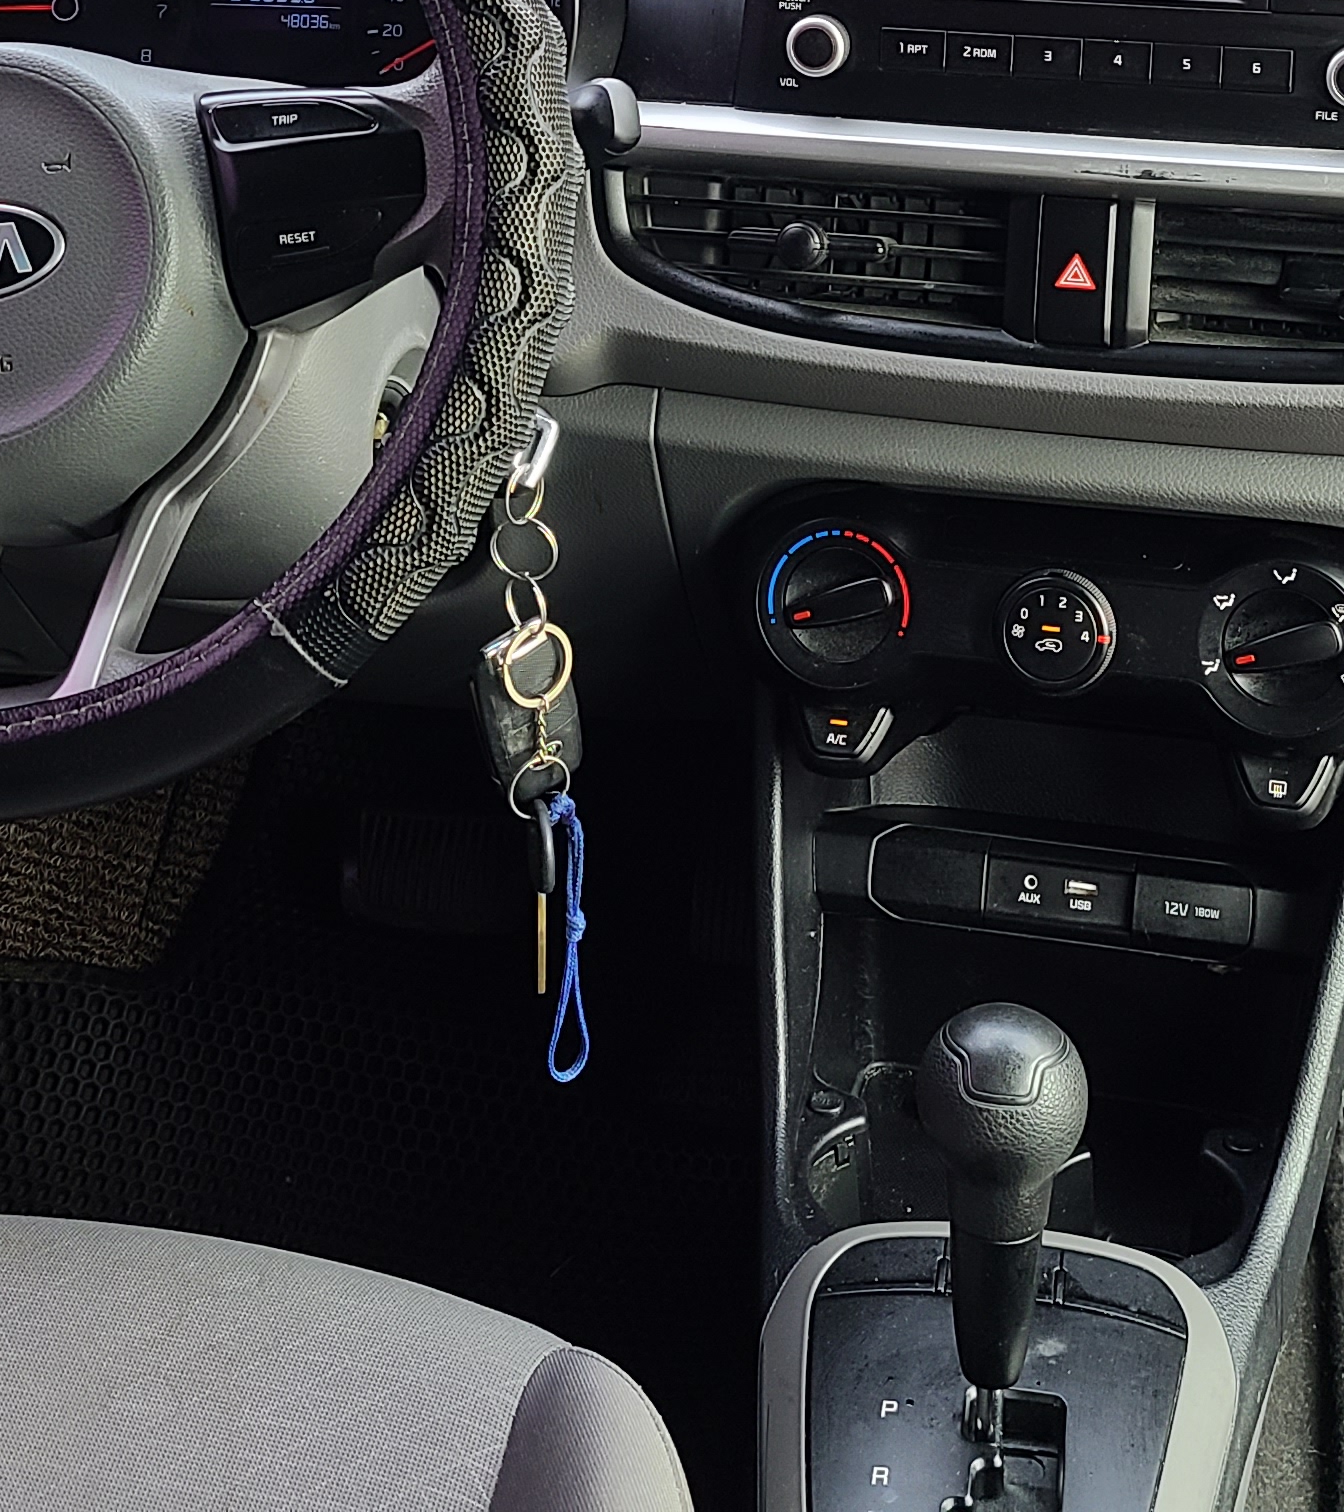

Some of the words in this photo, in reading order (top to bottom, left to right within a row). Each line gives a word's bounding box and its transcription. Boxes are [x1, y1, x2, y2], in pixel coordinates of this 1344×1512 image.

[156, 4, 167, 18] 7
[779, 2, 802, 10] PUSH
[382, 24, 403, 37] 20
[907, 44, 928, 54] RPT
[963, 46, 971, 57] 2
[973, 48, 997, 59] RDM
[141, 49, 151, 62] 8
[1044, 50, 1052, 62] 3
[1113, 54, 1122, 67] 4
[394, 57, 404, 71] 0
[1183, 58, 1191, 70] 5
[1252, 62, 1261, 74] 6
[780, 78, 799, 88] VOL
[272, 114, 298, 126] TRIP
[1315, 111, 1338, 122] FILE
[279, 231, 316, 245] RESET
[1039, 595, 1045, 606] 1
[1059, 597, 1067, 608] 2
[1020, 608, 1028, 619] 0
[1075, 610, 1083, 622] 3
[1080, 631, 1090, 642] 4
[826, 733, 847, 745] A/C
[1018, 892, 1041, 904] AUX
[1069, 899, 1092, 911] USB
[1164, 901, 1189, 917] 12V
[881, 1399, 898, 1418] P
[871, 1466, 889, 1486] R
